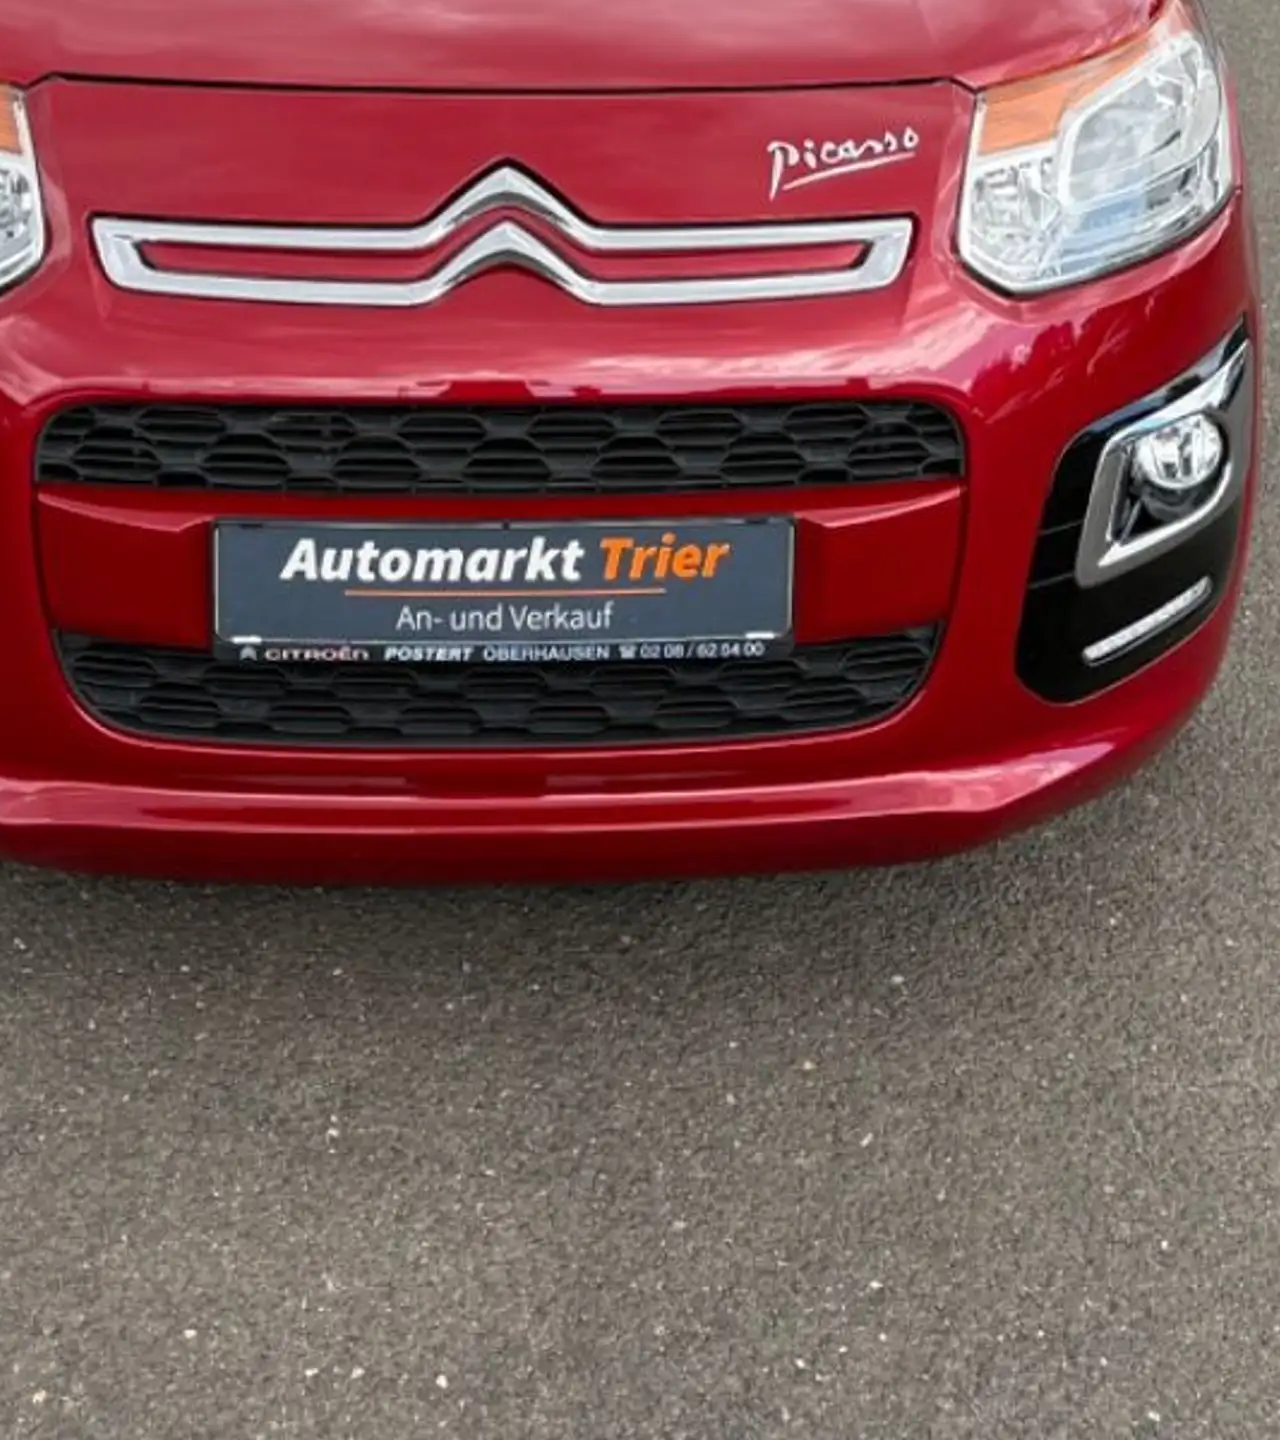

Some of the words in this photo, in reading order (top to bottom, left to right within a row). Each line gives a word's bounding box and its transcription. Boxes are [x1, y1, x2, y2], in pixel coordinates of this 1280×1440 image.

[280, 536, 584, 583] Automarkt
[599, 532, 730, 582] Trier
[395, 605, 443, 631] An-
[449, 603, 503, 631] und
[509, 601, 616, 630] Verkauf
[384, 645, 476, 661] POSTERT
[483, 644, 611, 661] OBERHAUSEN
